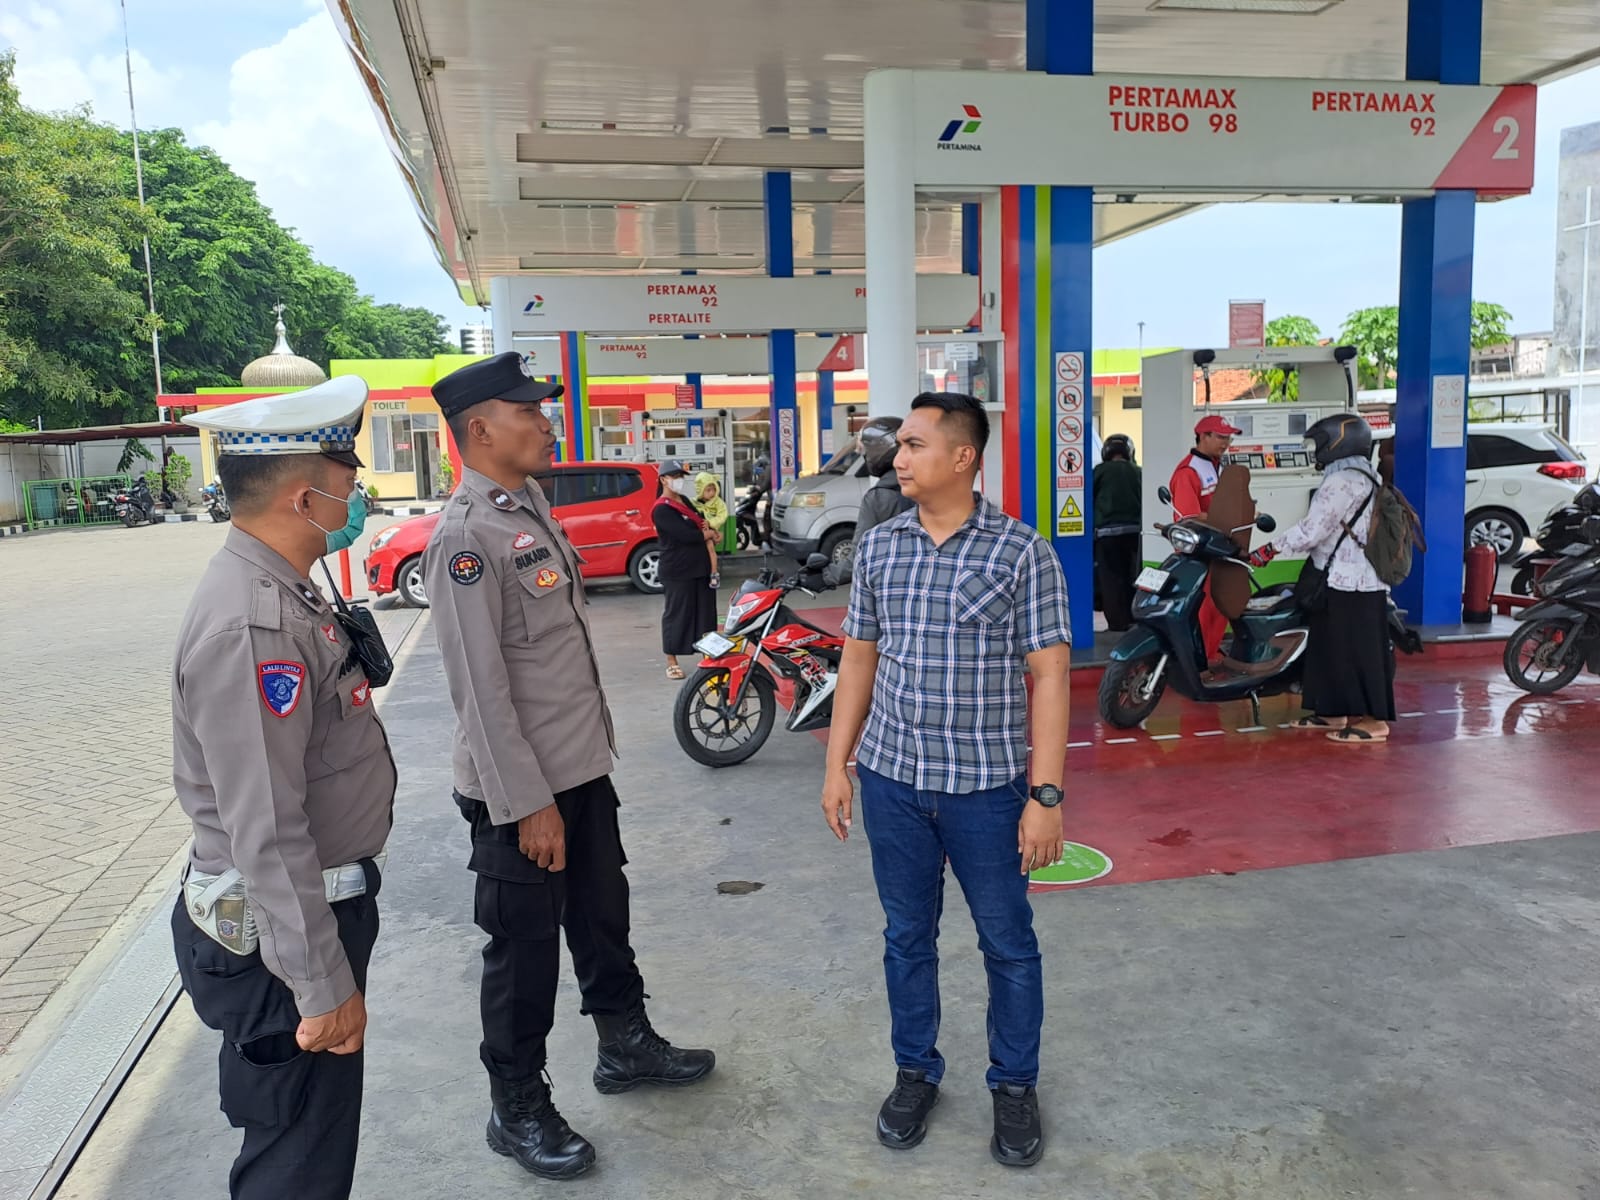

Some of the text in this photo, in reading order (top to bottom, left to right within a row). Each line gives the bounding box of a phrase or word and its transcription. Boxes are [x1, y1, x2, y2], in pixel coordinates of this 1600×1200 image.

[1108, 85, 1237, 109] PERTAMAX
[1312, 91, 1436, 113] PERTAMAX
[1110, 111, 1238, 133] TURBO 98
[1409, 117, 1436, 136] 92
[1492, 115, 1520, 159] 2
[936, 142, 982, 152] PERTAMINA
[647, 284, 717, 295] PERTAMAX
[702, 296, 718, 307] 92
[649, 313, 711, 323] PERTALITE
[600, 344, 647, 352] PERTAMAX
[836, 346, 848, 361] 4
[373, 402, 406, 410] TOILET
